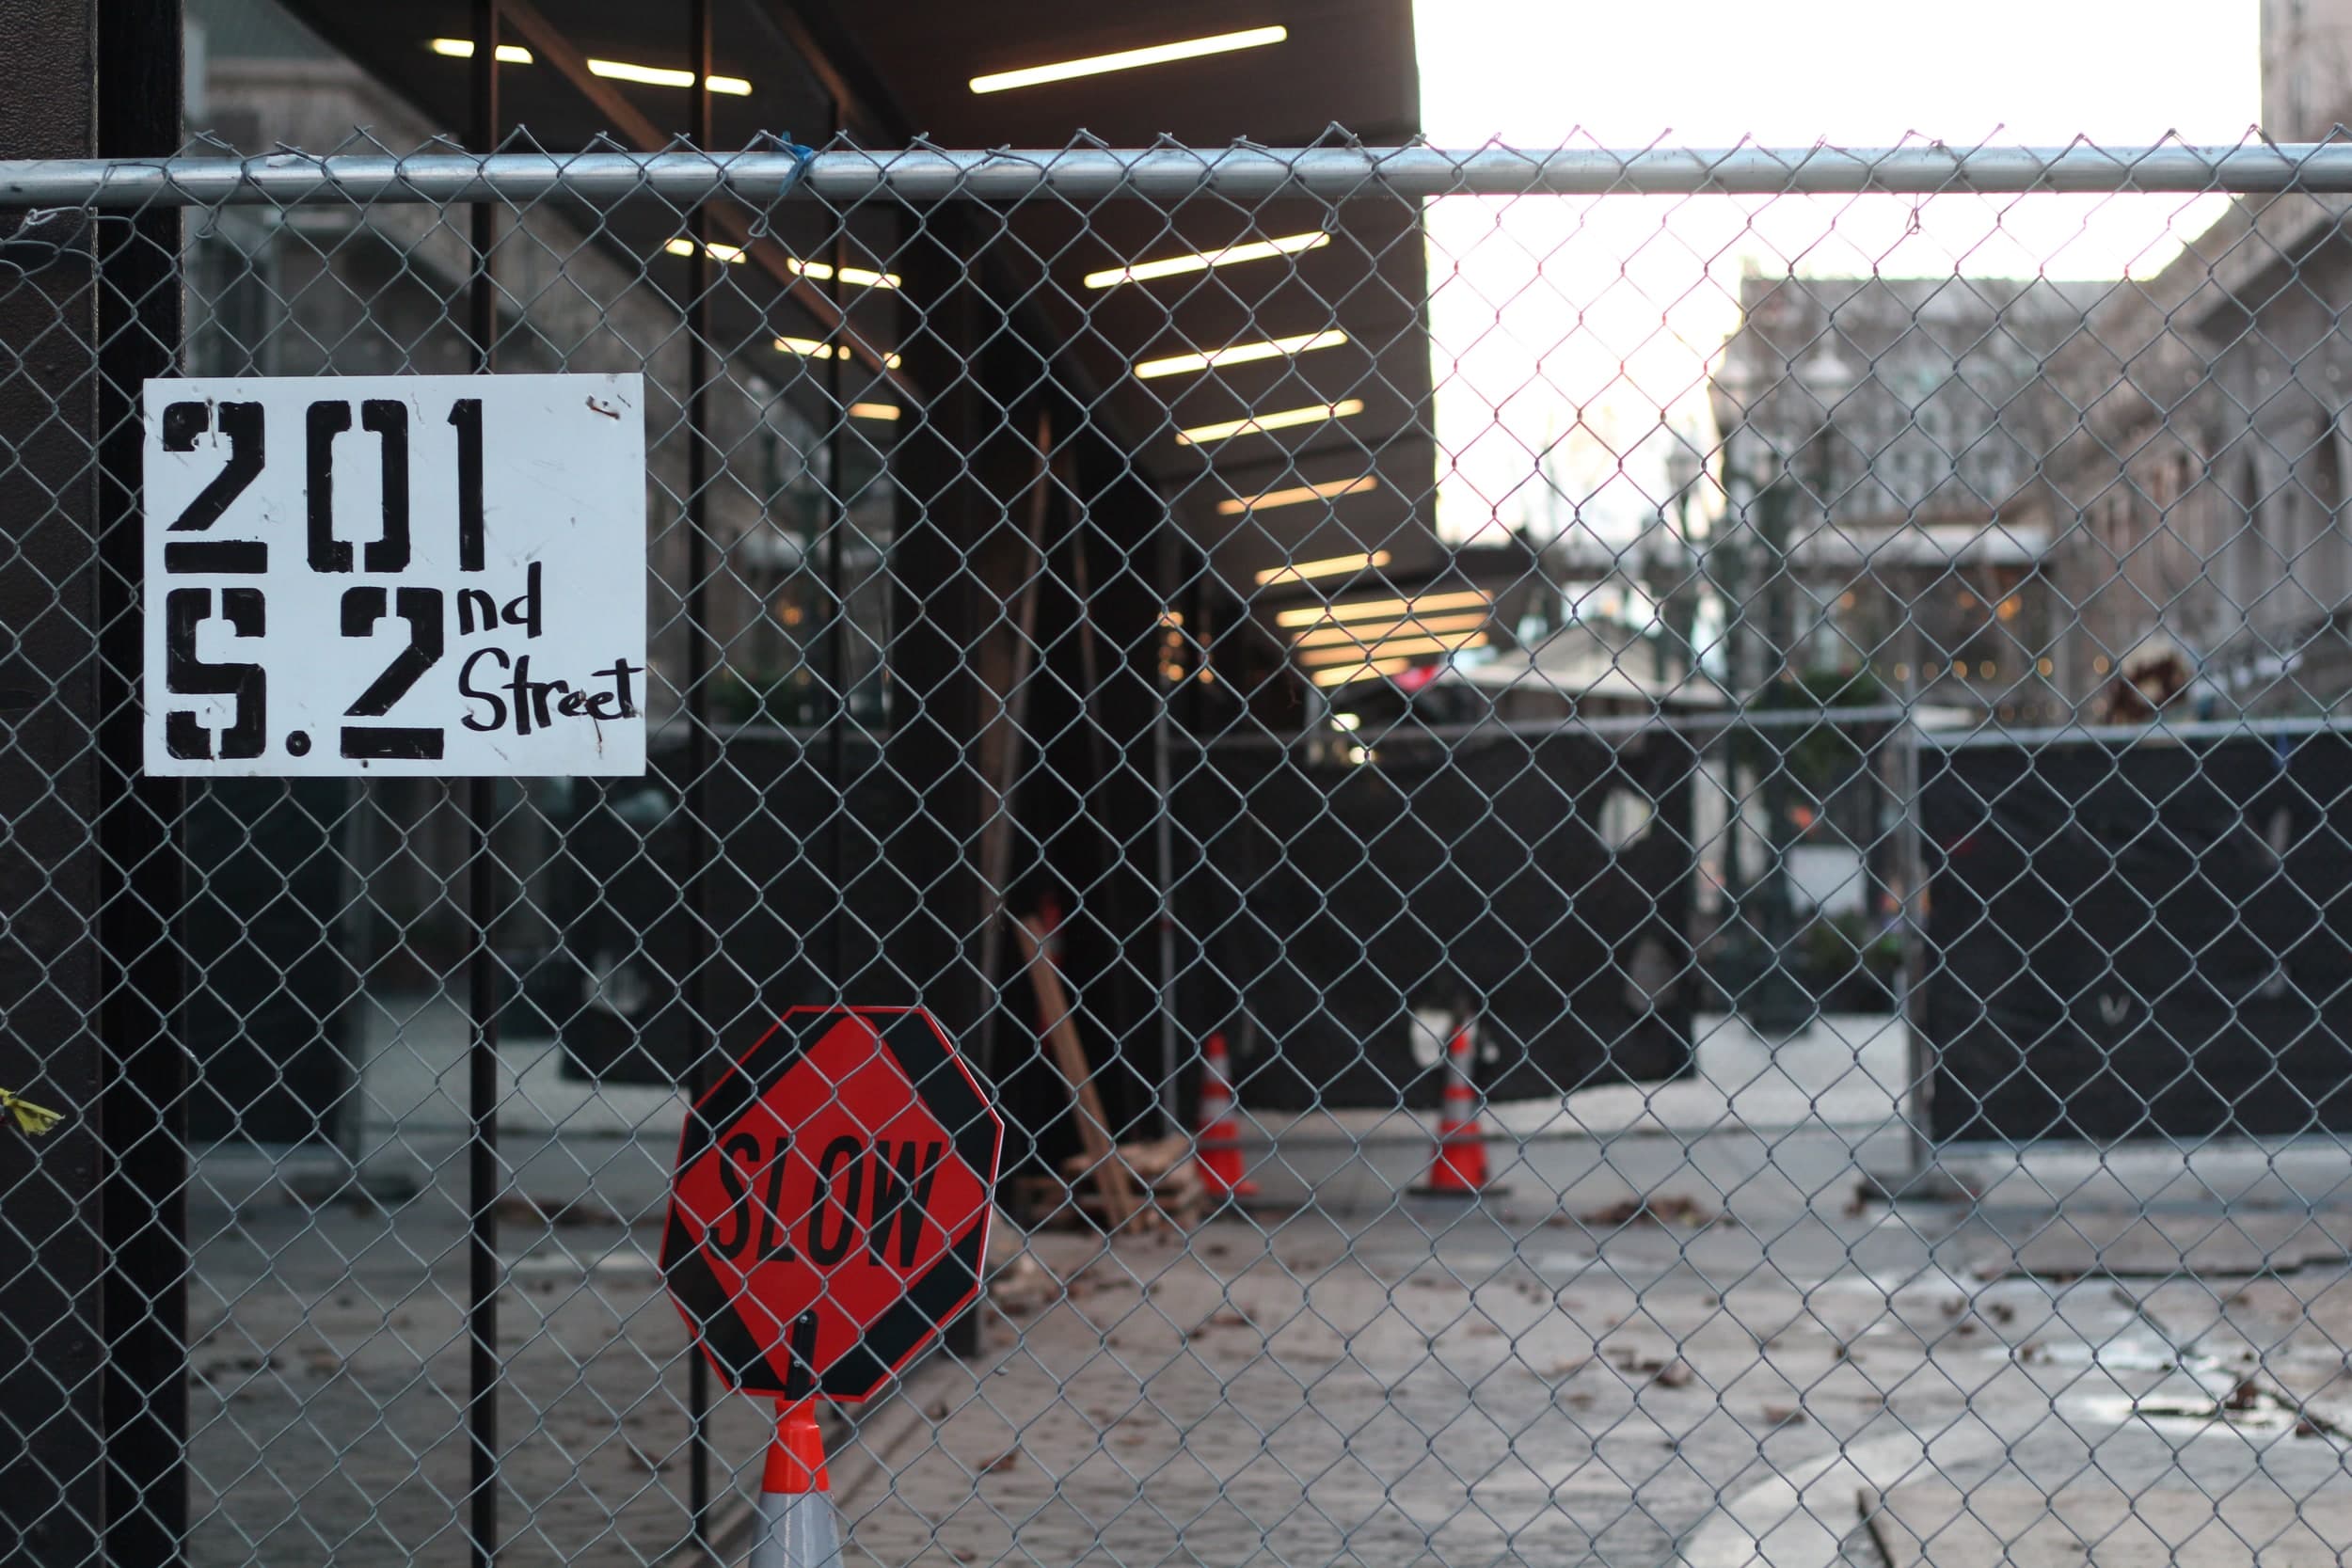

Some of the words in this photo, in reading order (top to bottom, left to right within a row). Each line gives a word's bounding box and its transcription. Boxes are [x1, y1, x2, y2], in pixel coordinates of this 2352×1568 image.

[162, 398, 485, 575] 201
[165, 587, 312, 761] S.
[458, 646, 644, 736] Street
[706, 1132, 943, 1269] SLOW
